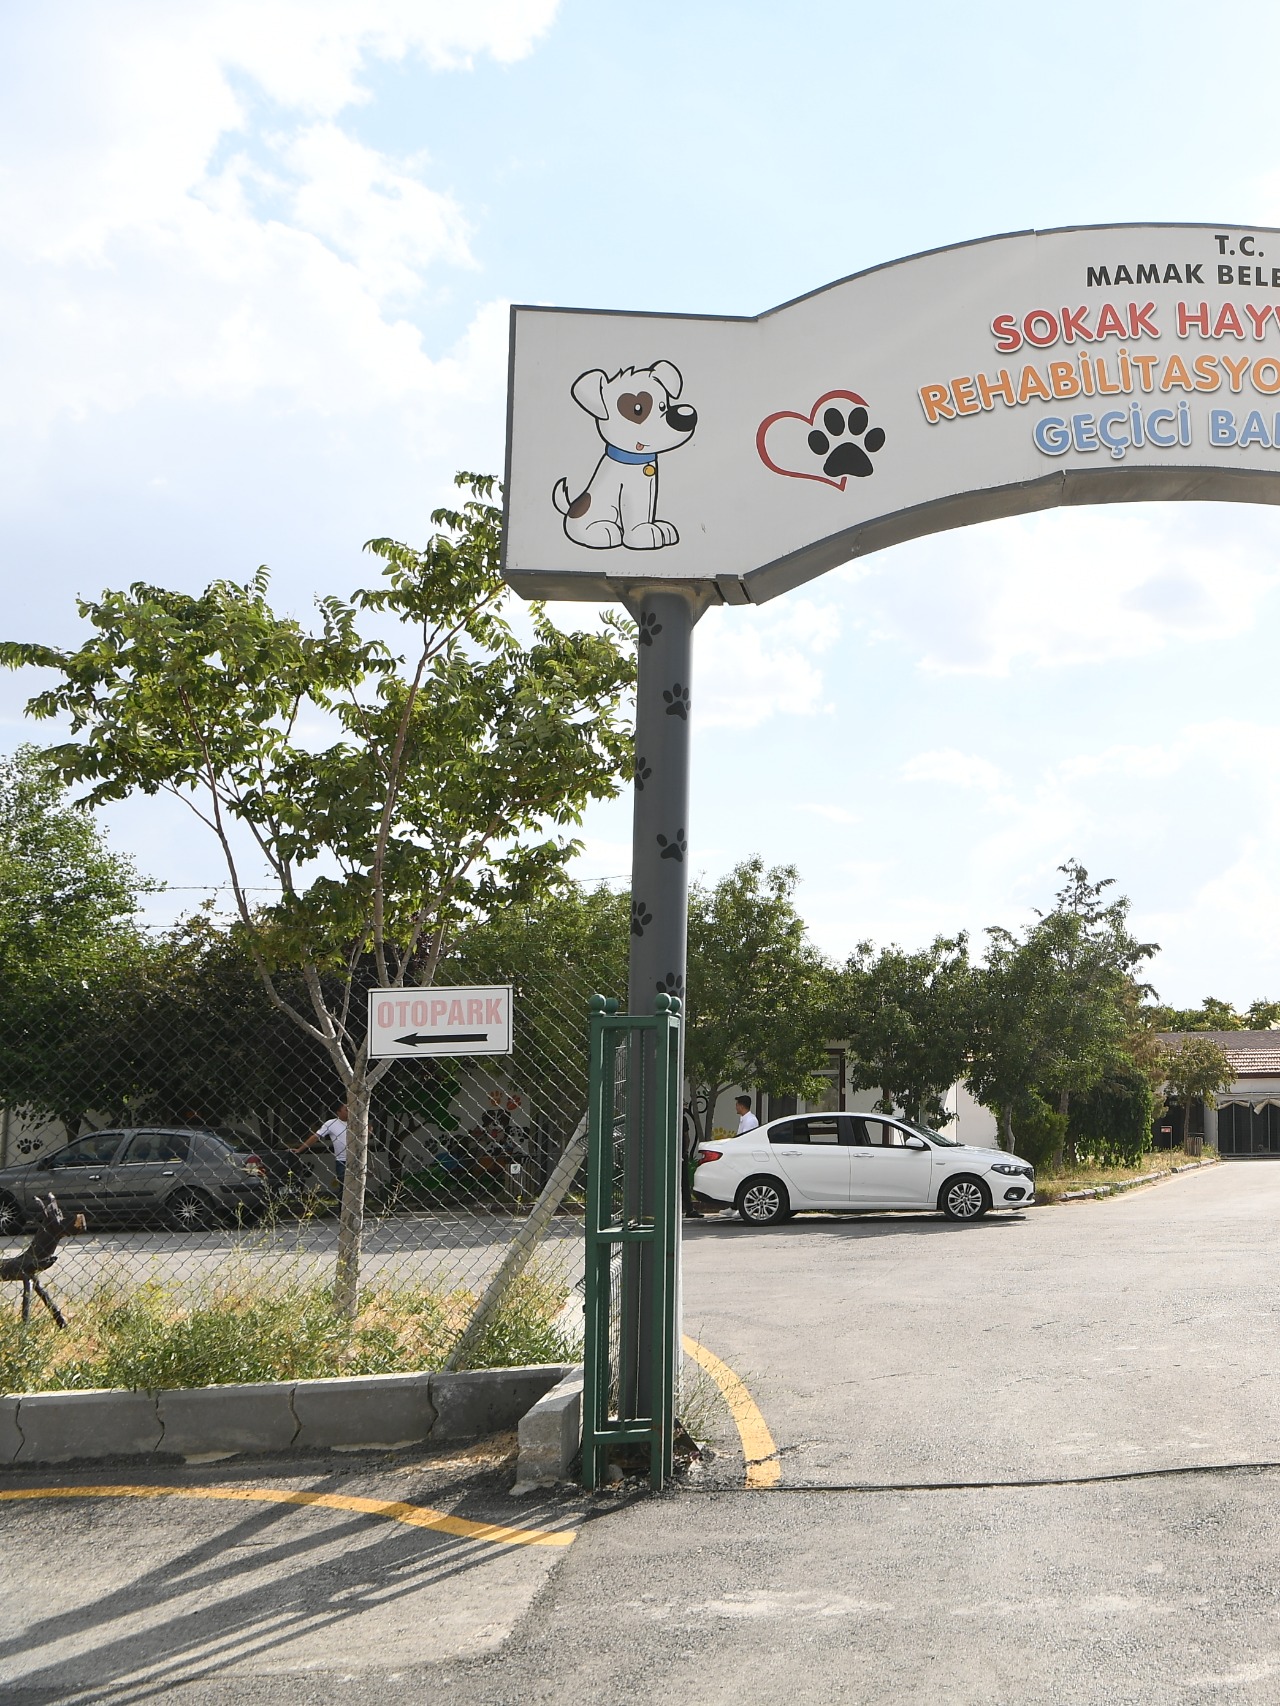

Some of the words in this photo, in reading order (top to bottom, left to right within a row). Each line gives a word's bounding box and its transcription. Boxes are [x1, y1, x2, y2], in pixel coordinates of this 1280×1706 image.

[1214, 234, 1264, 258] T.C.
[1086, 263, 1204, 288] MAMAK
[990, 302, 1160, 353] SOKAK
[1033, 400, 1192, 459] GEÇİCİ
[377, 998, 503, 1028] OTOPARK
